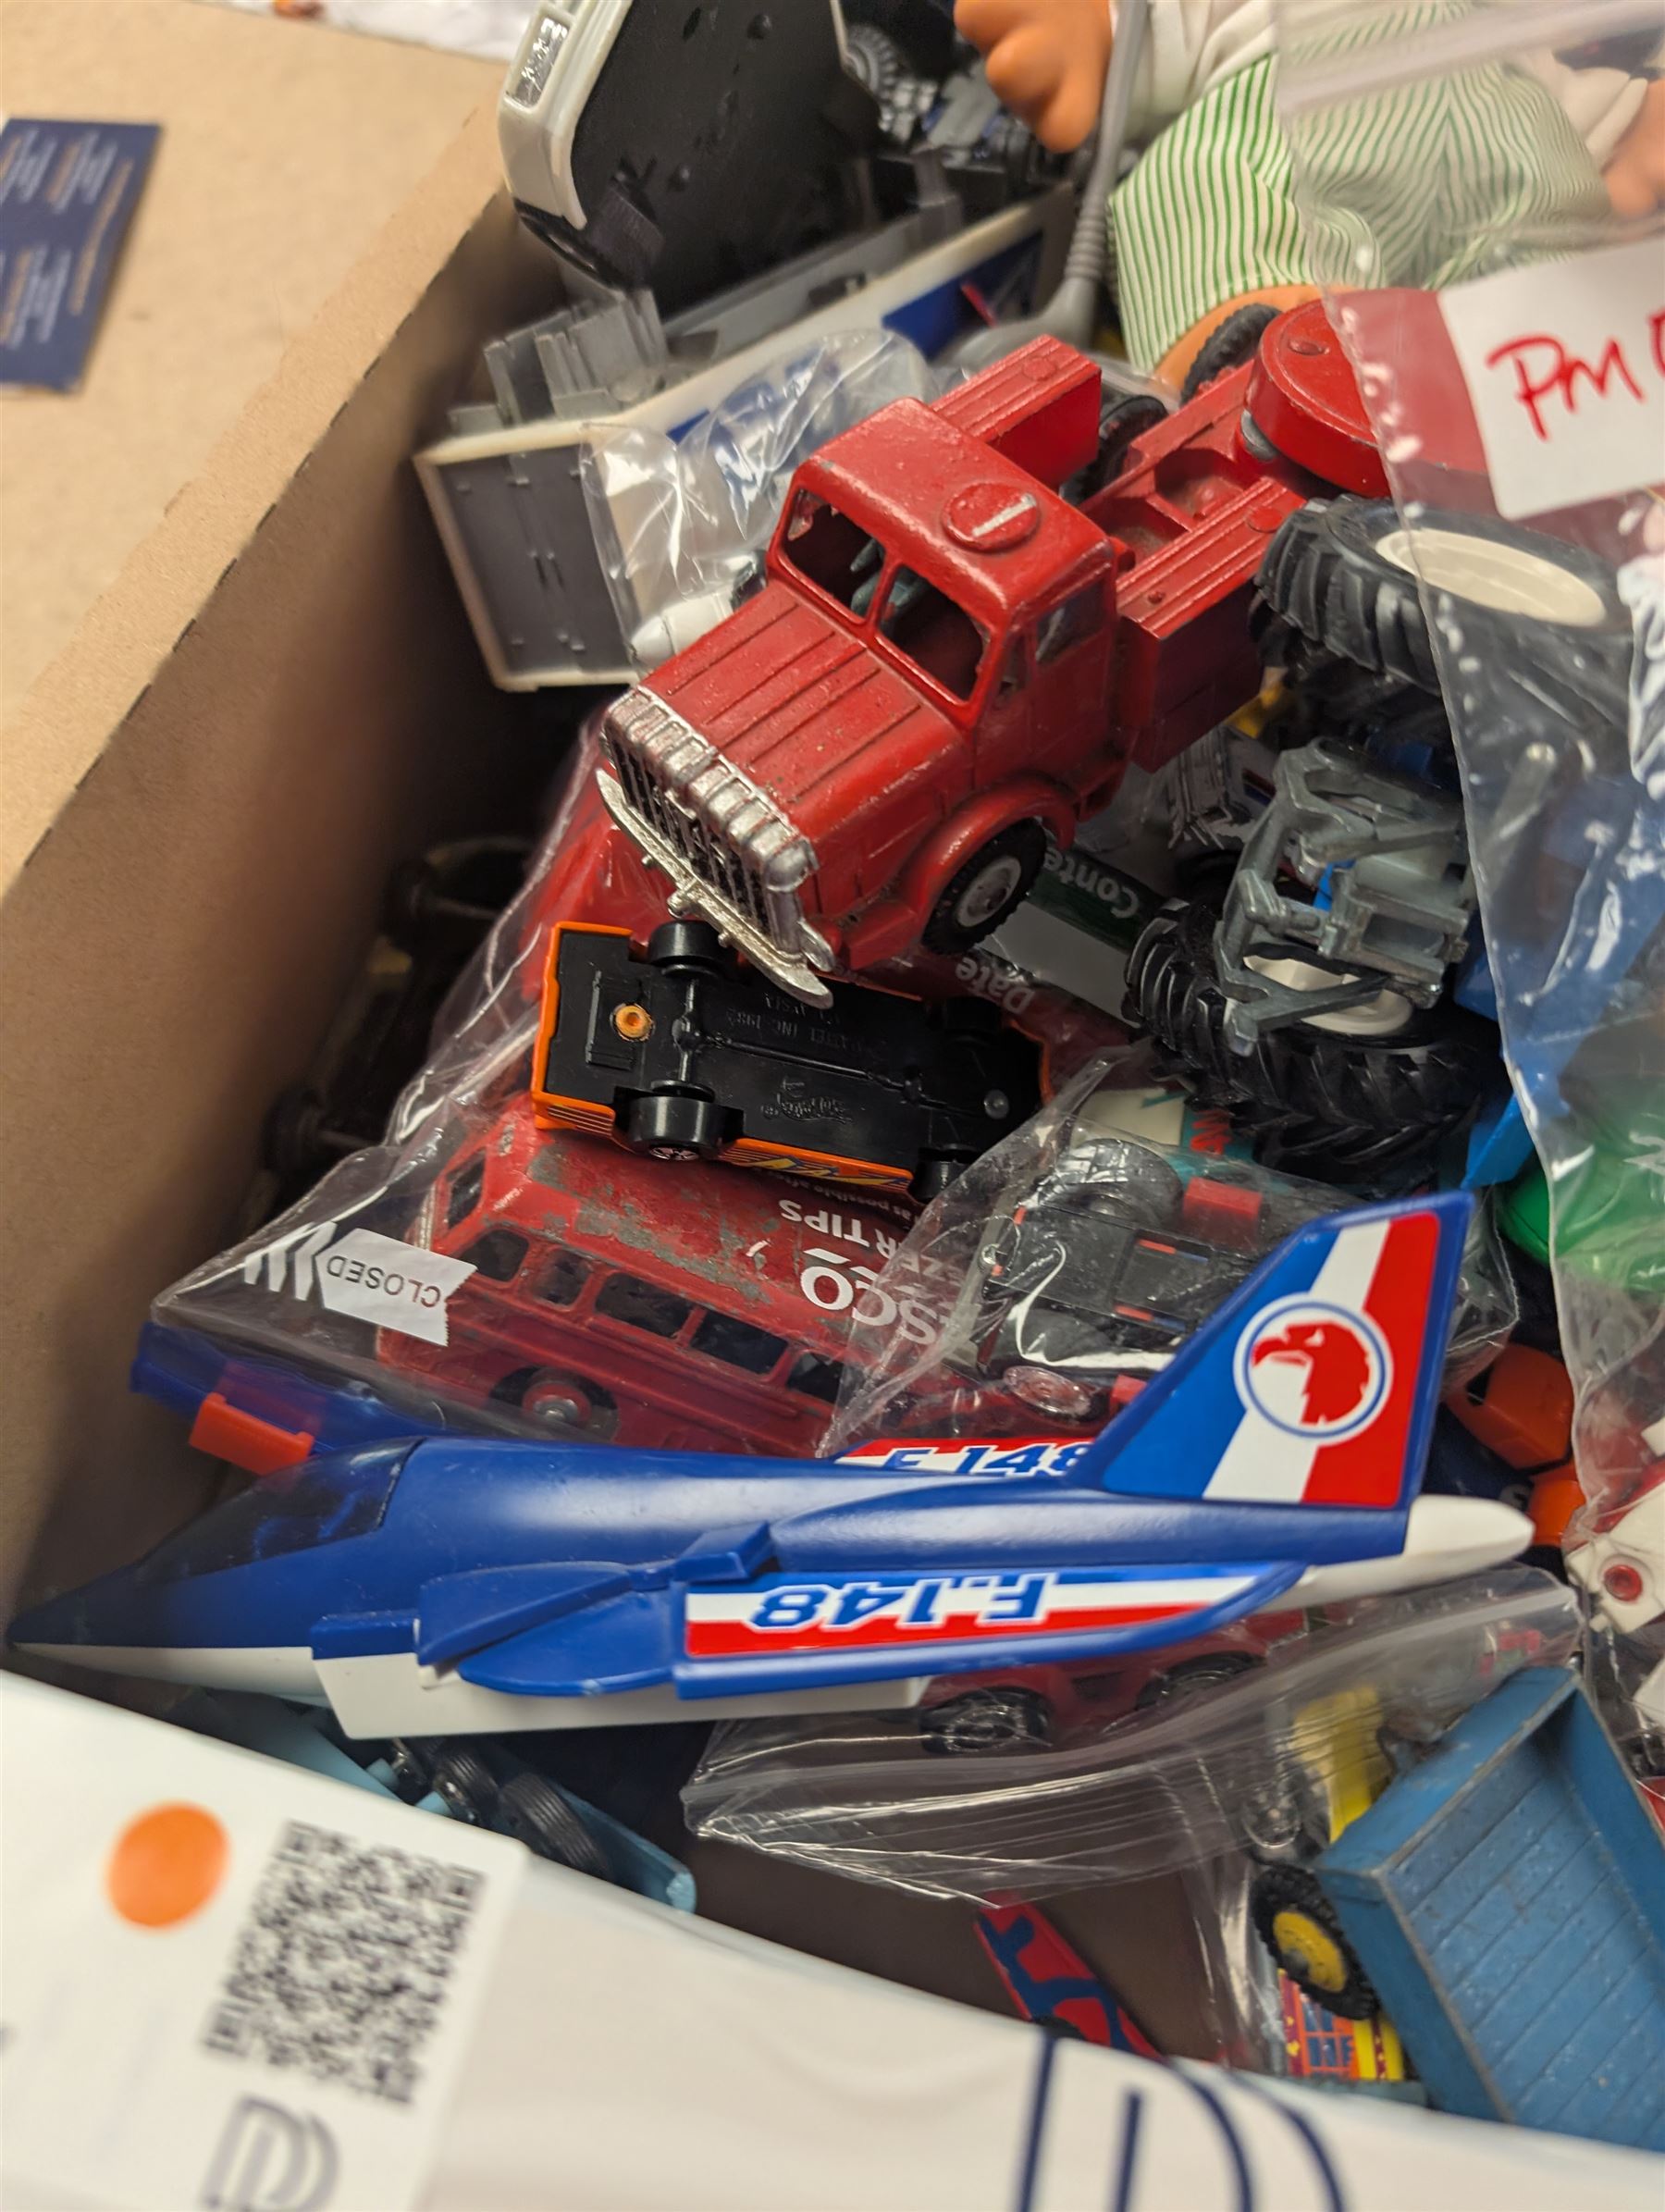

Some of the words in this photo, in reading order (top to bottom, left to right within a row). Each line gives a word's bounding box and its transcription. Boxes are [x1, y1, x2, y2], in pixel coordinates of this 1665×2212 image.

[1485, 332, 1645, 442] PM
[1043, 846, 1140, 919] Conte
[955, 956, 1036, 1015] Date
[778, 1199, 870, 1248] TIPS
[326, 1254, 442, 1309] CLOSED
[800, 1266, 954, 1345] SCO
[743, 1572, 1058, 1634] F.148
